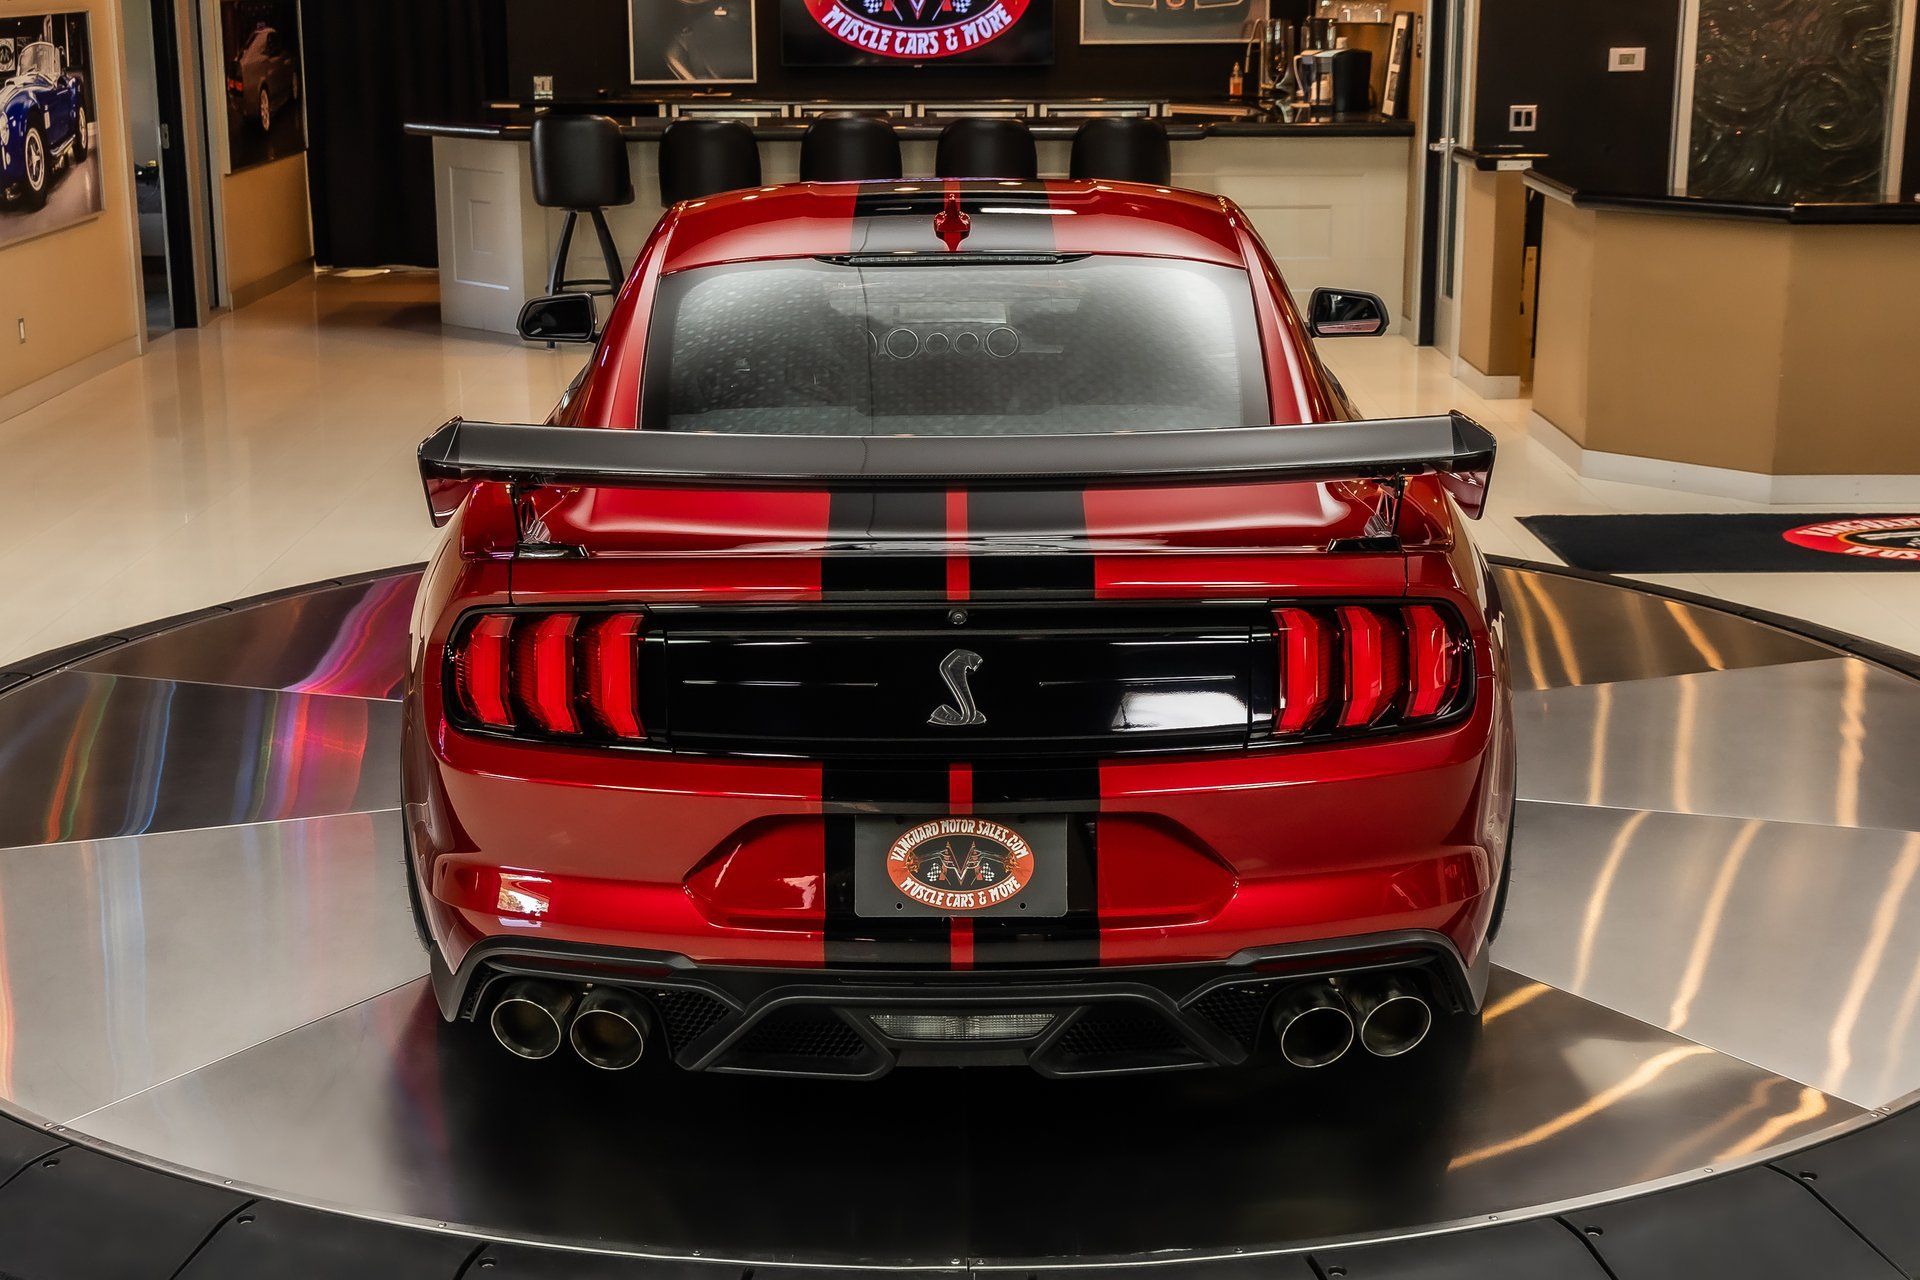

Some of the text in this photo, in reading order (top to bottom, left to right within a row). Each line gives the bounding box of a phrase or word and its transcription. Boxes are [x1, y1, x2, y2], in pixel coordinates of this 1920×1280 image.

[821, 3, 1012, 55] MUSCLE CARS & MORE
[890, 819, 1029, 862] VANGUARD MOTOR SALES.COM
[900, 875, 1022, 908] MUSCLE CARS & MORE
